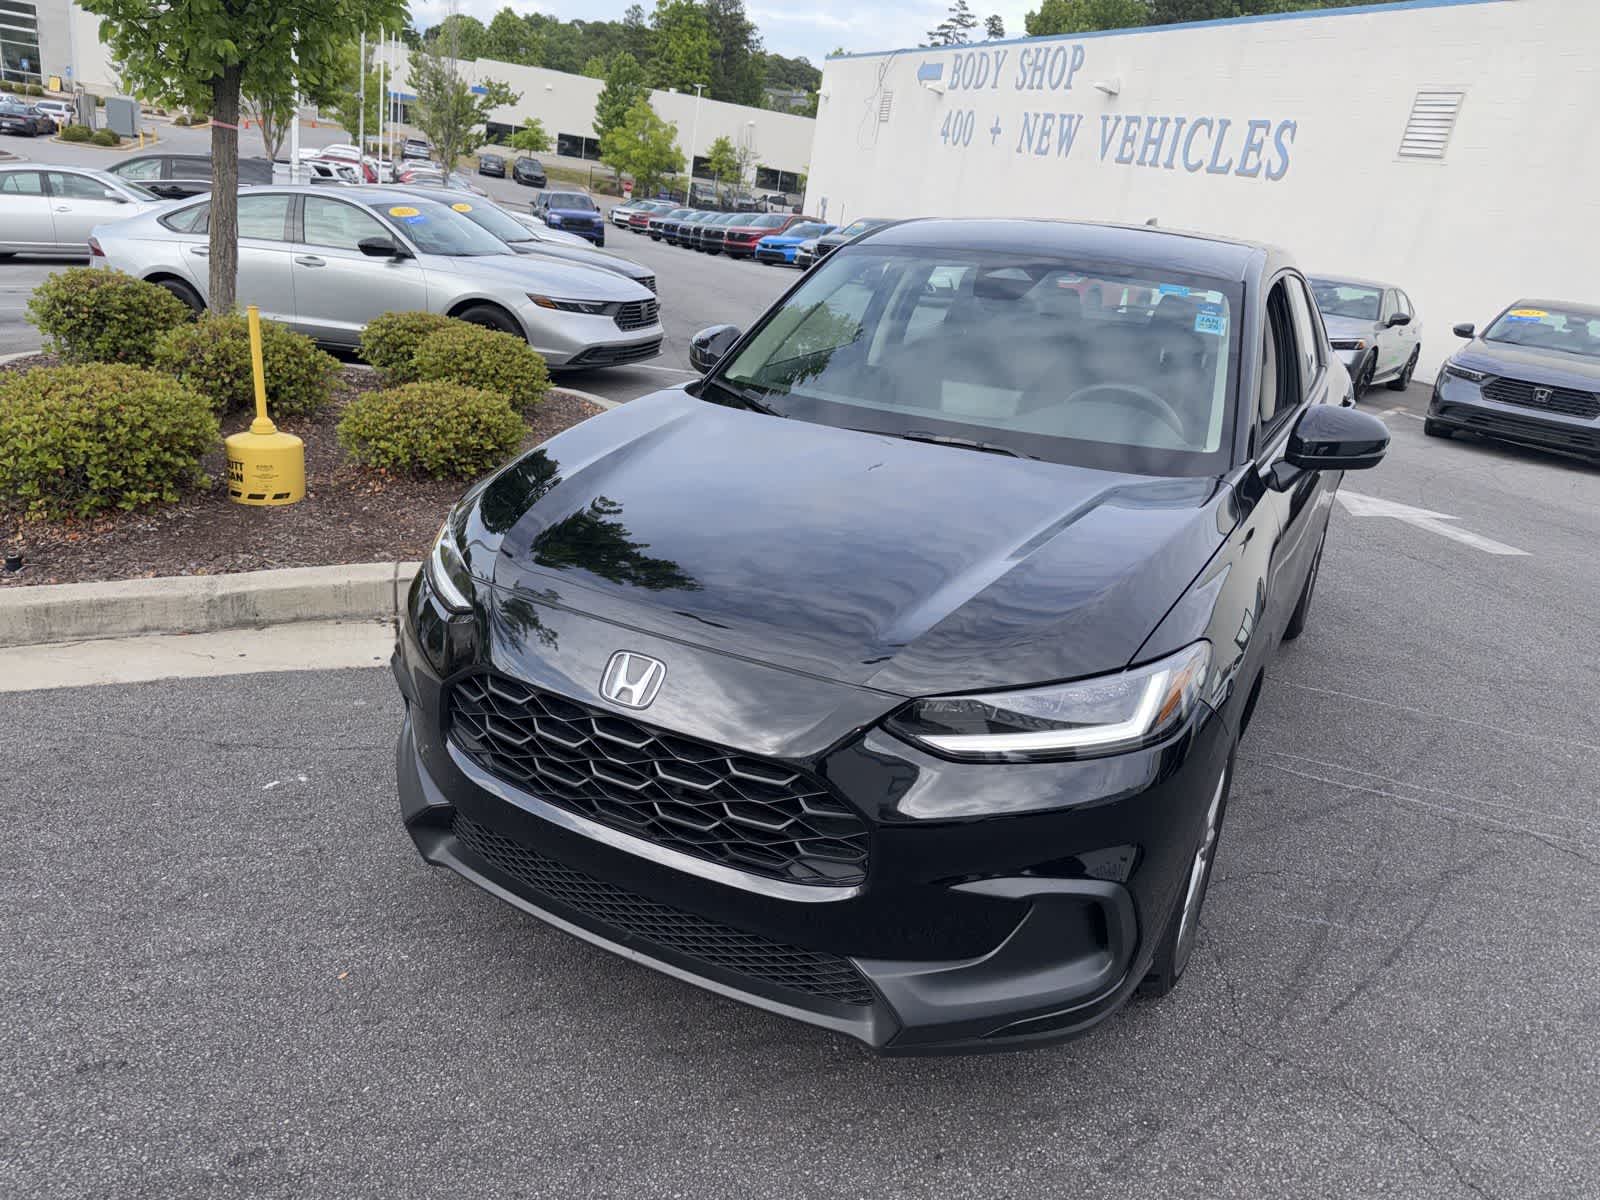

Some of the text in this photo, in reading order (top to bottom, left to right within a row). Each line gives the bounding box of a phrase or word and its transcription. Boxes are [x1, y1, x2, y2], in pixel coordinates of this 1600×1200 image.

[949, 44, 1086, 91] BODY SHOP
[940, 109, 1298, 182] 400 + NEW VEHICLES
